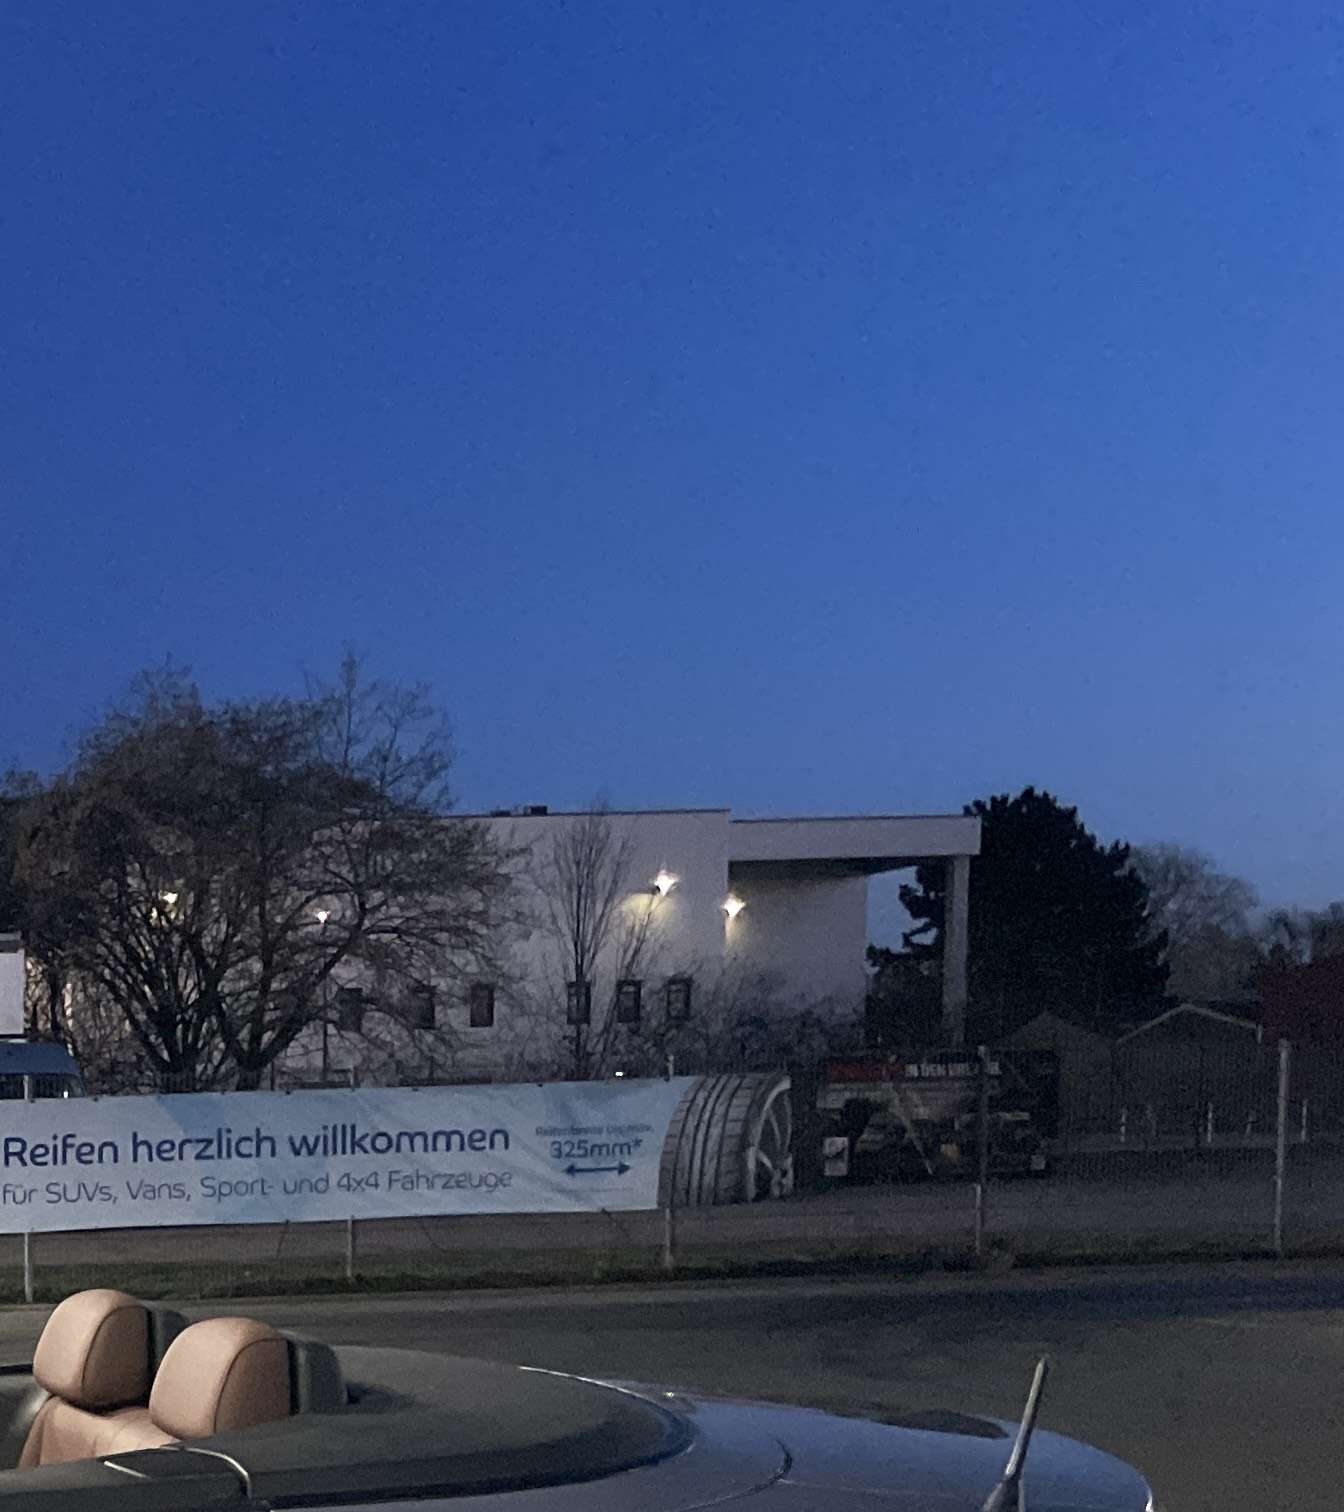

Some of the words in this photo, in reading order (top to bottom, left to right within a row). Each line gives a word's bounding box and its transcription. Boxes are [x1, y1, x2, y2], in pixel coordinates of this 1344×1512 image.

[3, 1133, 119, 1168] Reifen
[131, 1127, 277, 1163] herzlich
[288, 1123, 512, 1158] willkommen
[2, 1183, 38, 1205] für
[45, 1181, 119, 1204] SUVs,
[126, 1179, 192, 1202] Vans,
[200, 1175, 274, 1203] Sport-
[283, 1172, 330, 1196] und
[336, 1171, 380, 1193] 4x4
[388, 1168, 513, 1192] Fahrzeuge
